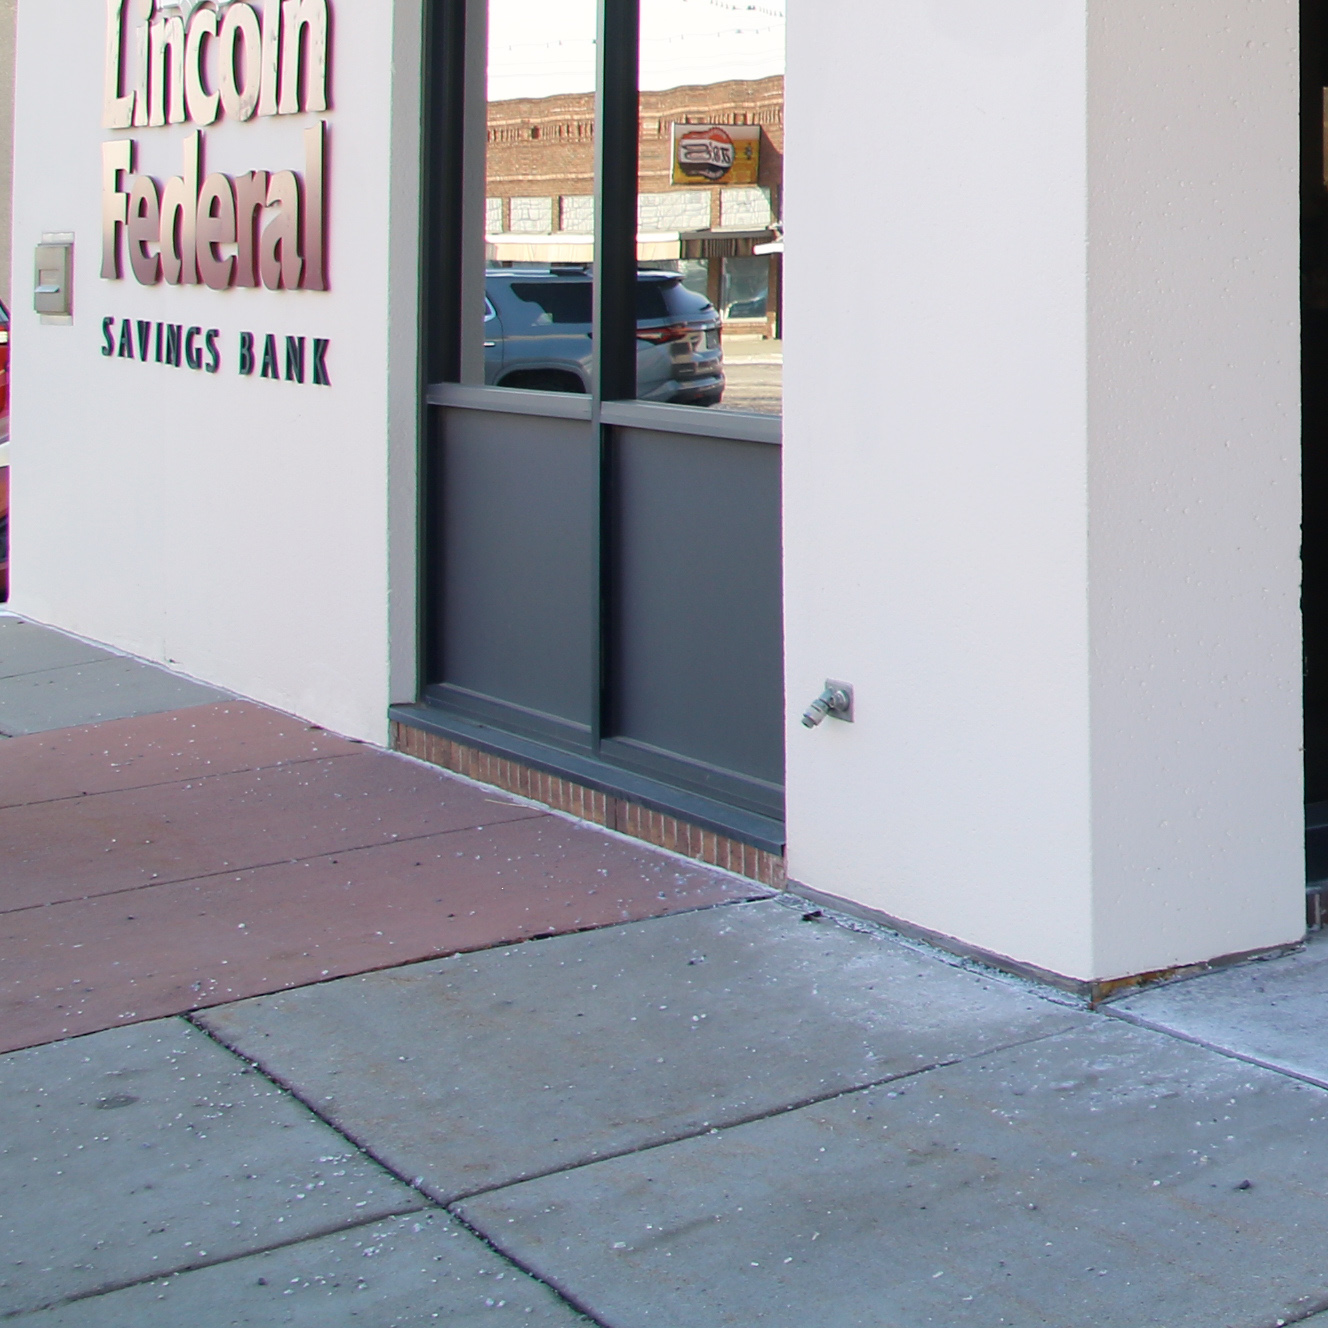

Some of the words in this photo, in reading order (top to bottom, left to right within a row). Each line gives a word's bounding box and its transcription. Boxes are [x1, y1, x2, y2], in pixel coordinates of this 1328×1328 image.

[101, 119, 330, 291] Federal
[101, 317, 220, 374] SAVINGS
[239, 331, 331, 386] BANK
